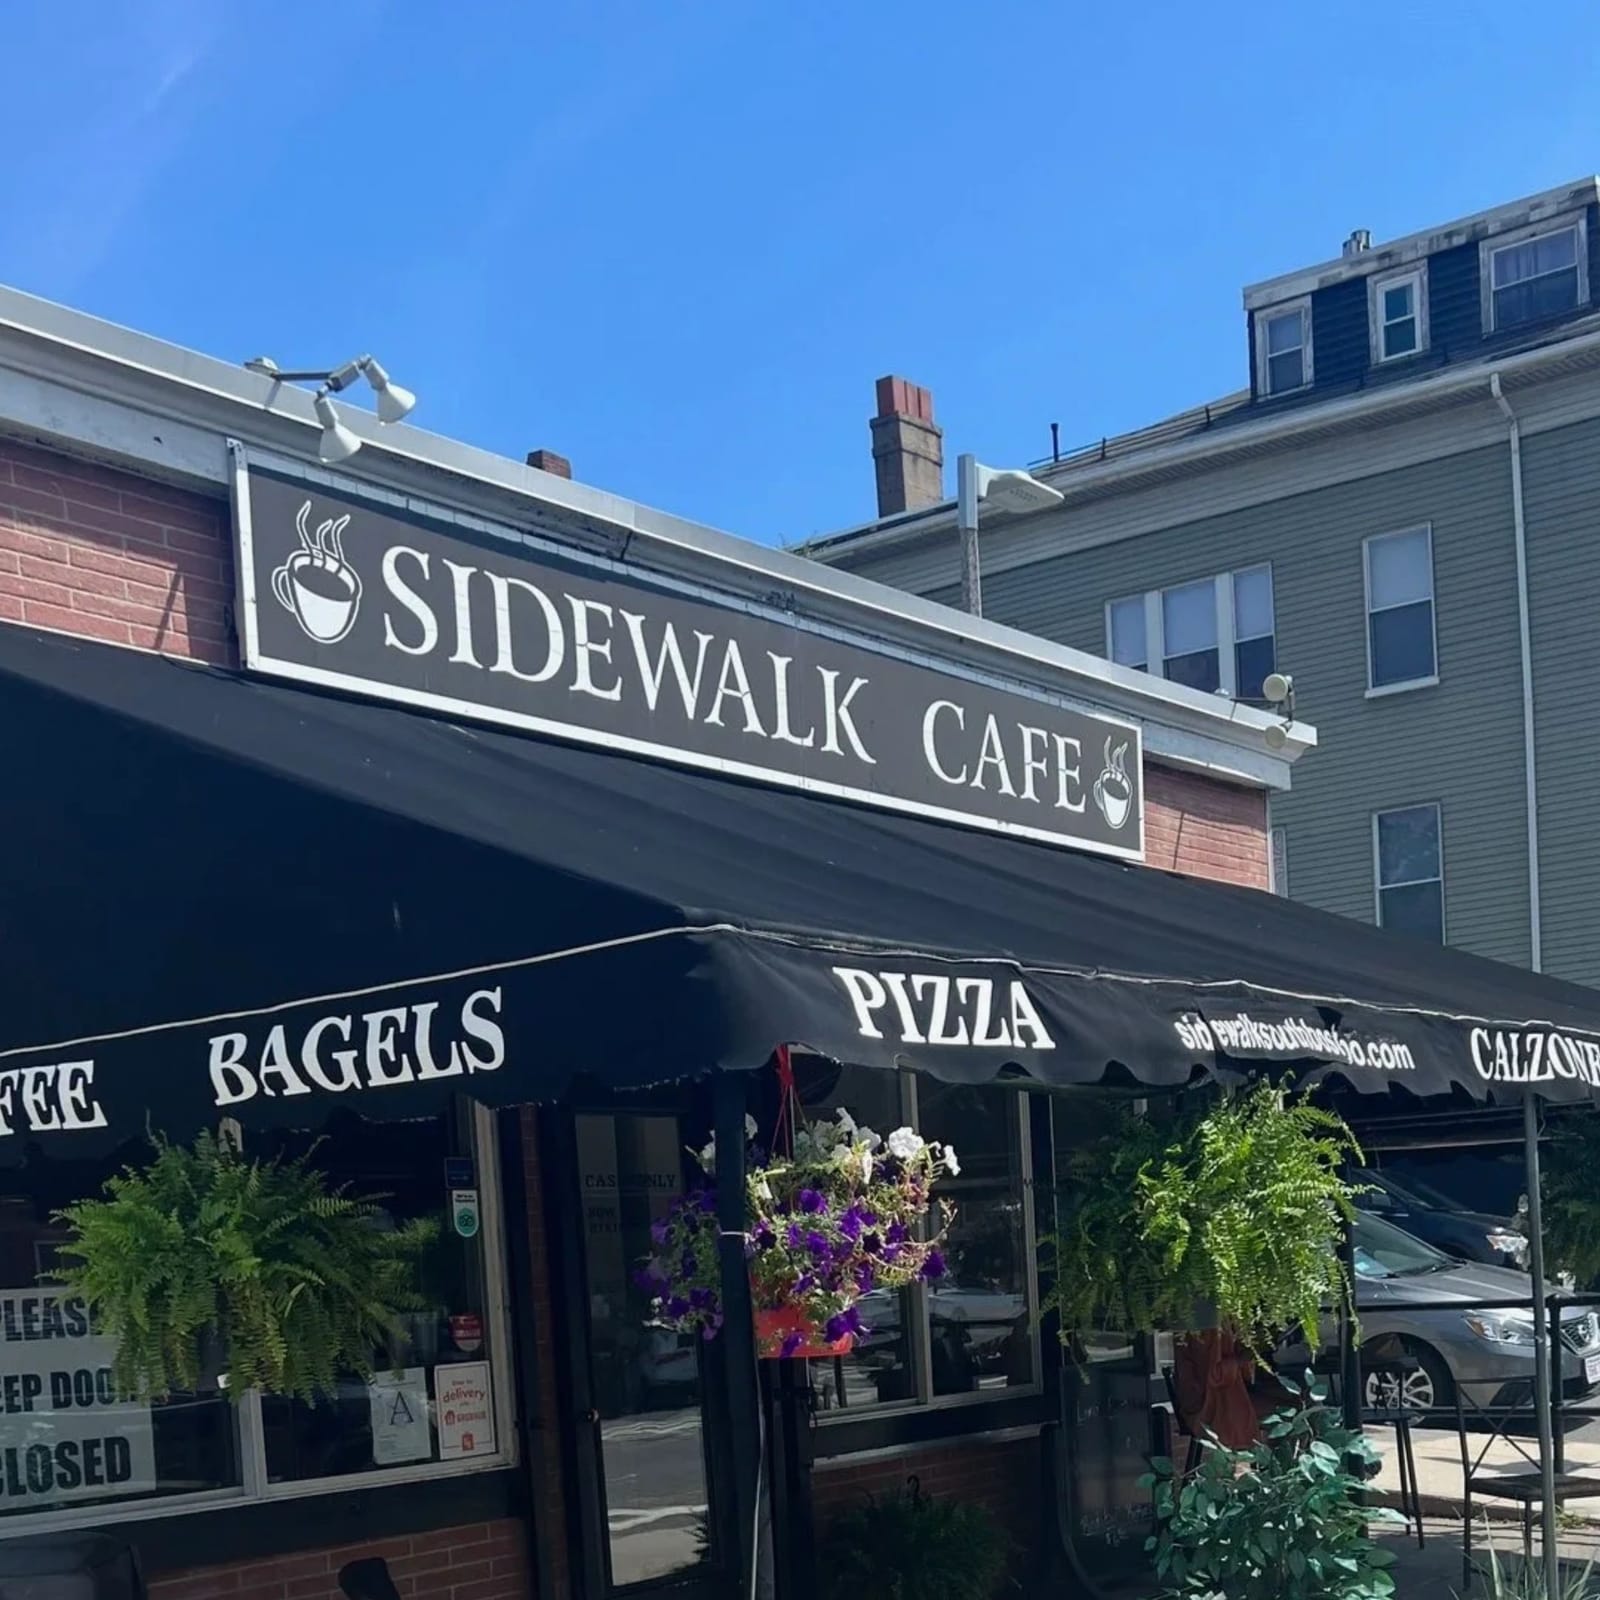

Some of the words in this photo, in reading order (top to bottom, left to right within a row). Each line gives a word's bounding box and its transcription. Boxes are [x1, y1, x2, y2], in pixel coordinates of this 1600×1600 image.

[382, 545, 877, 765] SIDEWALK
[922, 700, 1086, 814] CAFE
[832, 966, 1056, 1049] PIZZA
[208, 986, 505, 1106] BAGELS
[0, 1296, 106, 1341] LEAS
[0, 1373, 42, 1413] EP
[50, 1367, 137, 1409] DOO
[389, 1391, 414, 1425] A
[443, 1386, 486, 1403] delivery
[0, 1436, 131, 1496] LOSED
